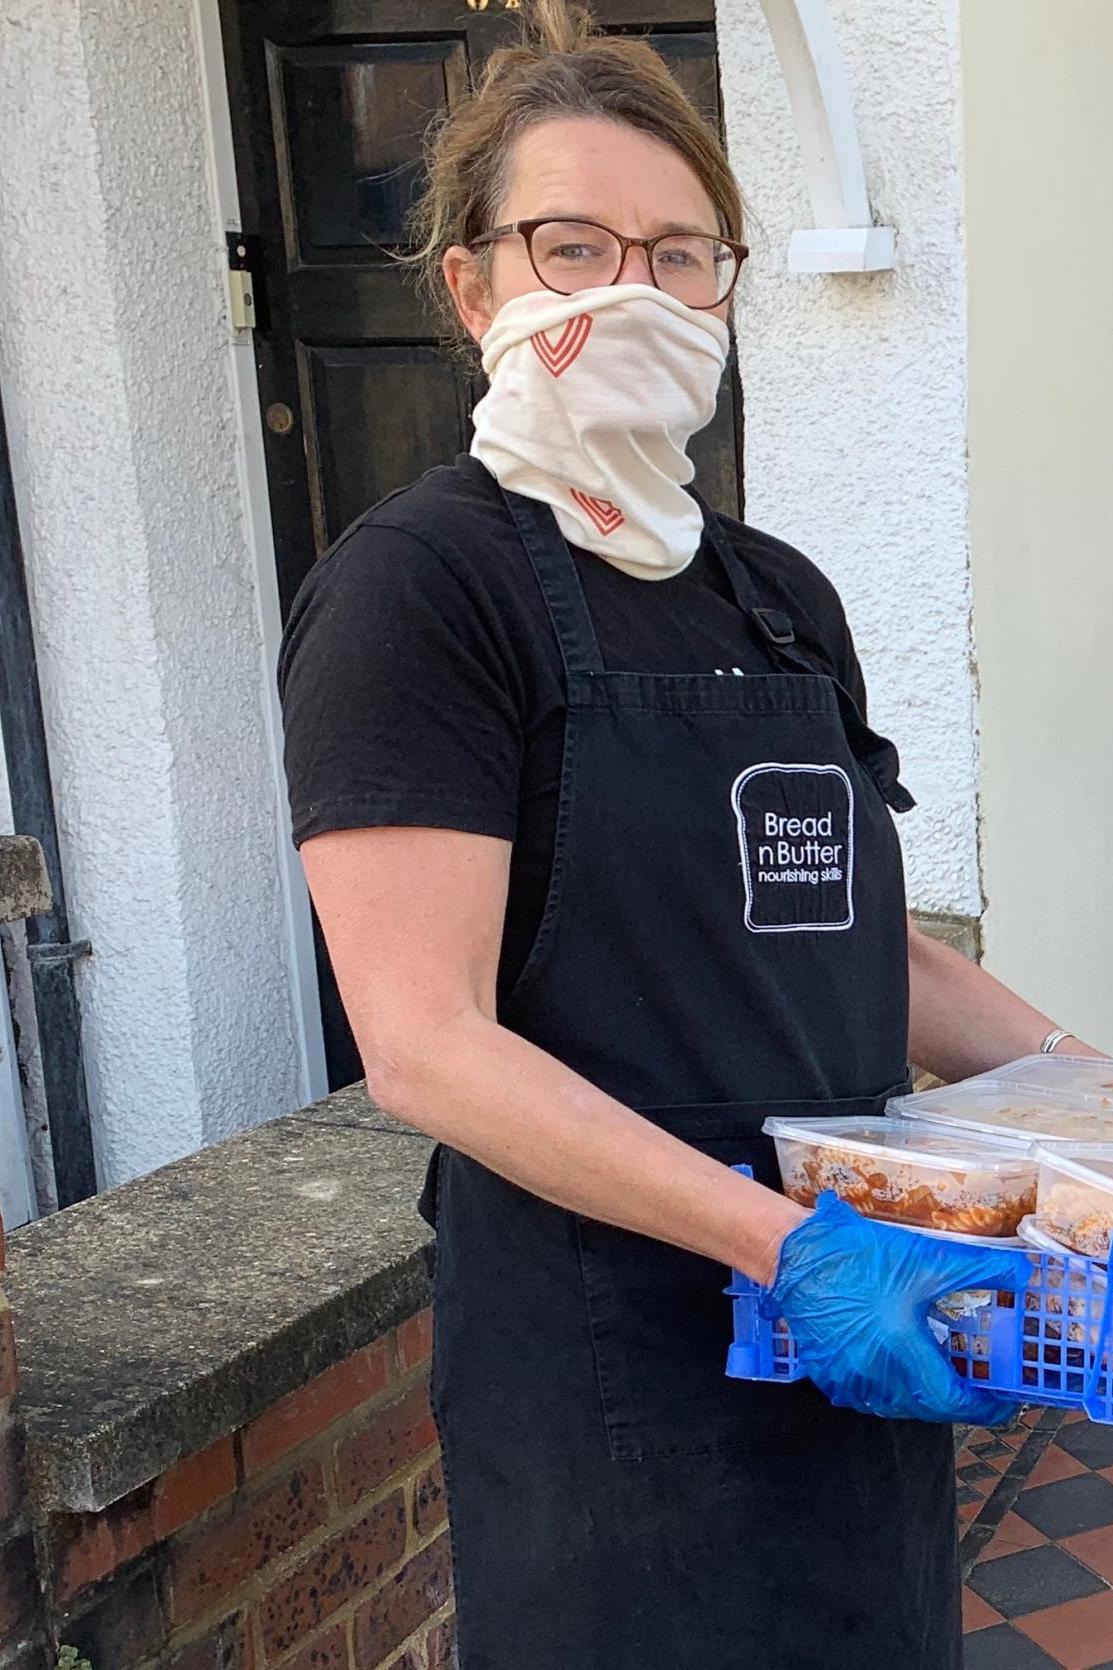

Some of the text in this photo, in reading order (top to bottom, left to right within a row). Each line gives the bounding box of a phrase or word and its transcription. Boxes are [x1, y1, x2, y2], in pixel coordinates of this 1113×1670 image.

[765, 811, 832, 837] Bread
[758, 841, 843, 865] n Butter
[758, 867, 843, 884] nourishing skills
